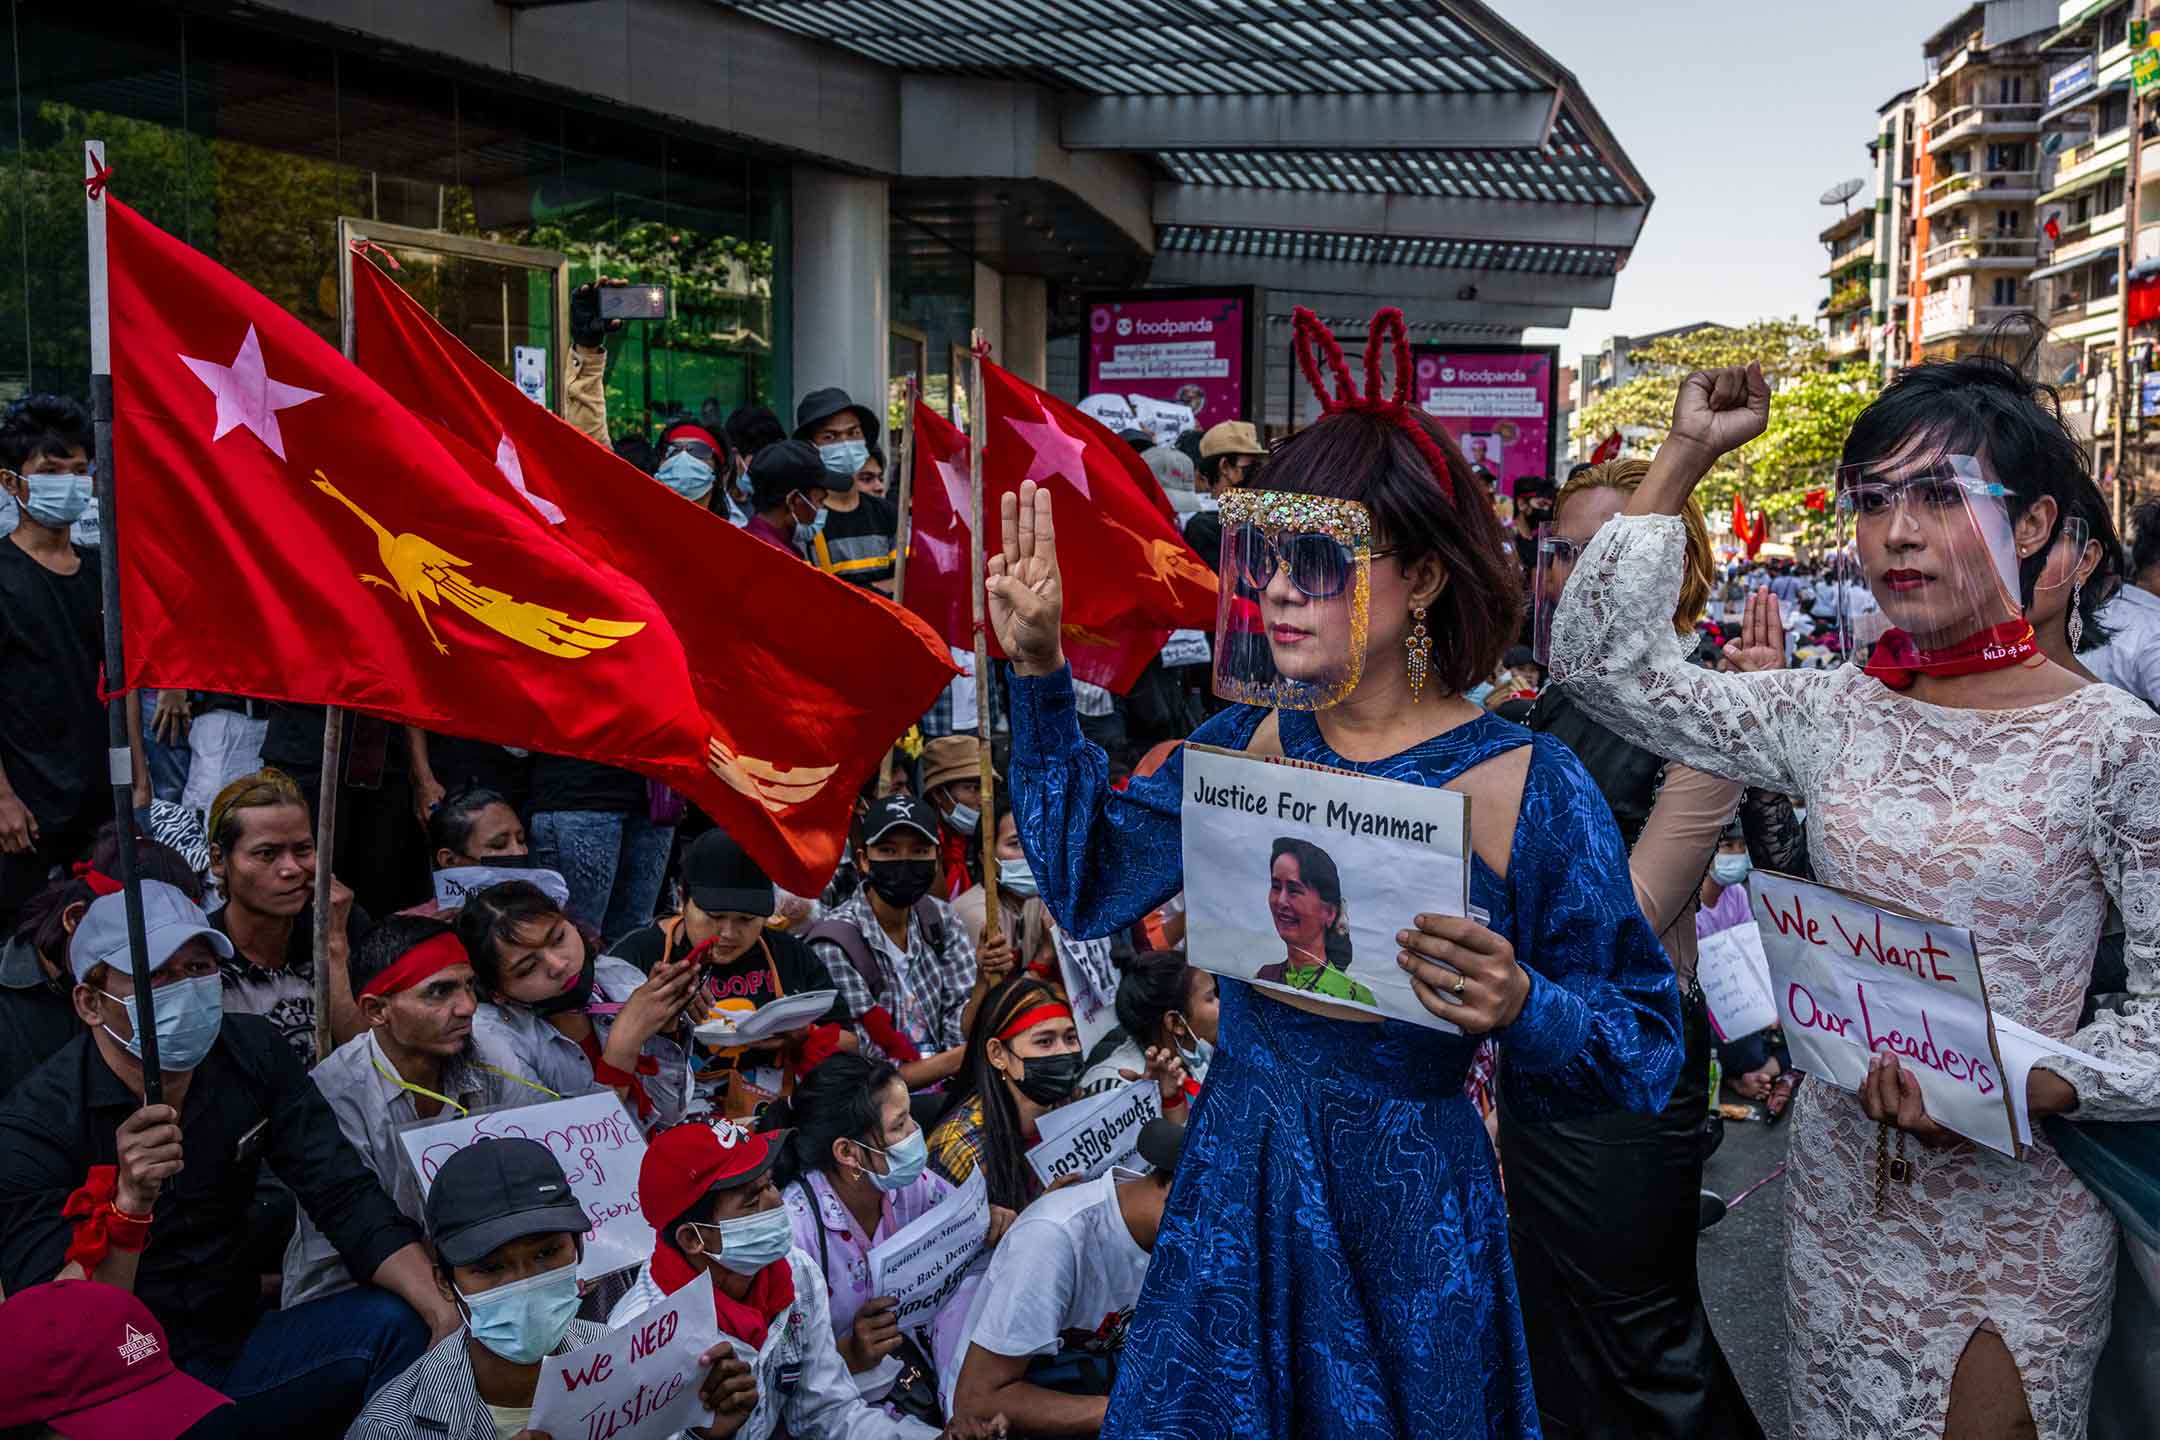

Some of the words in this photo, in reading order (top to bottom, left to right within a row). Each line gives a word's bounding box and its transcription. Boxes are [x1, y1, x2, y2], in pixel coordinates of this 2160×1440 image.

[1135, 317, 1213, 336] foodpanda
[1458, 368, 1527, 384] foodpanda
[1983, 648, 2006, 661] NLD
[1193, 776, 1268, 815] Justice
[1277, 791, 1317, 823] For
[1326, 799, 1438, 844] Myanmar
[1761, 893, 1828, 945] We
[1831, 912, 1958, 983] Want
[1788, 982, 1854, 1038] Our
[1857, 983, 1995, 1095] Leaders
[917, 1259, 944, 1286] Back
[119, 1335, 156, 1356] GIORDANO
[561, 1352, 614, 1393] We
[629, 1310, 679, 1365] NEED
